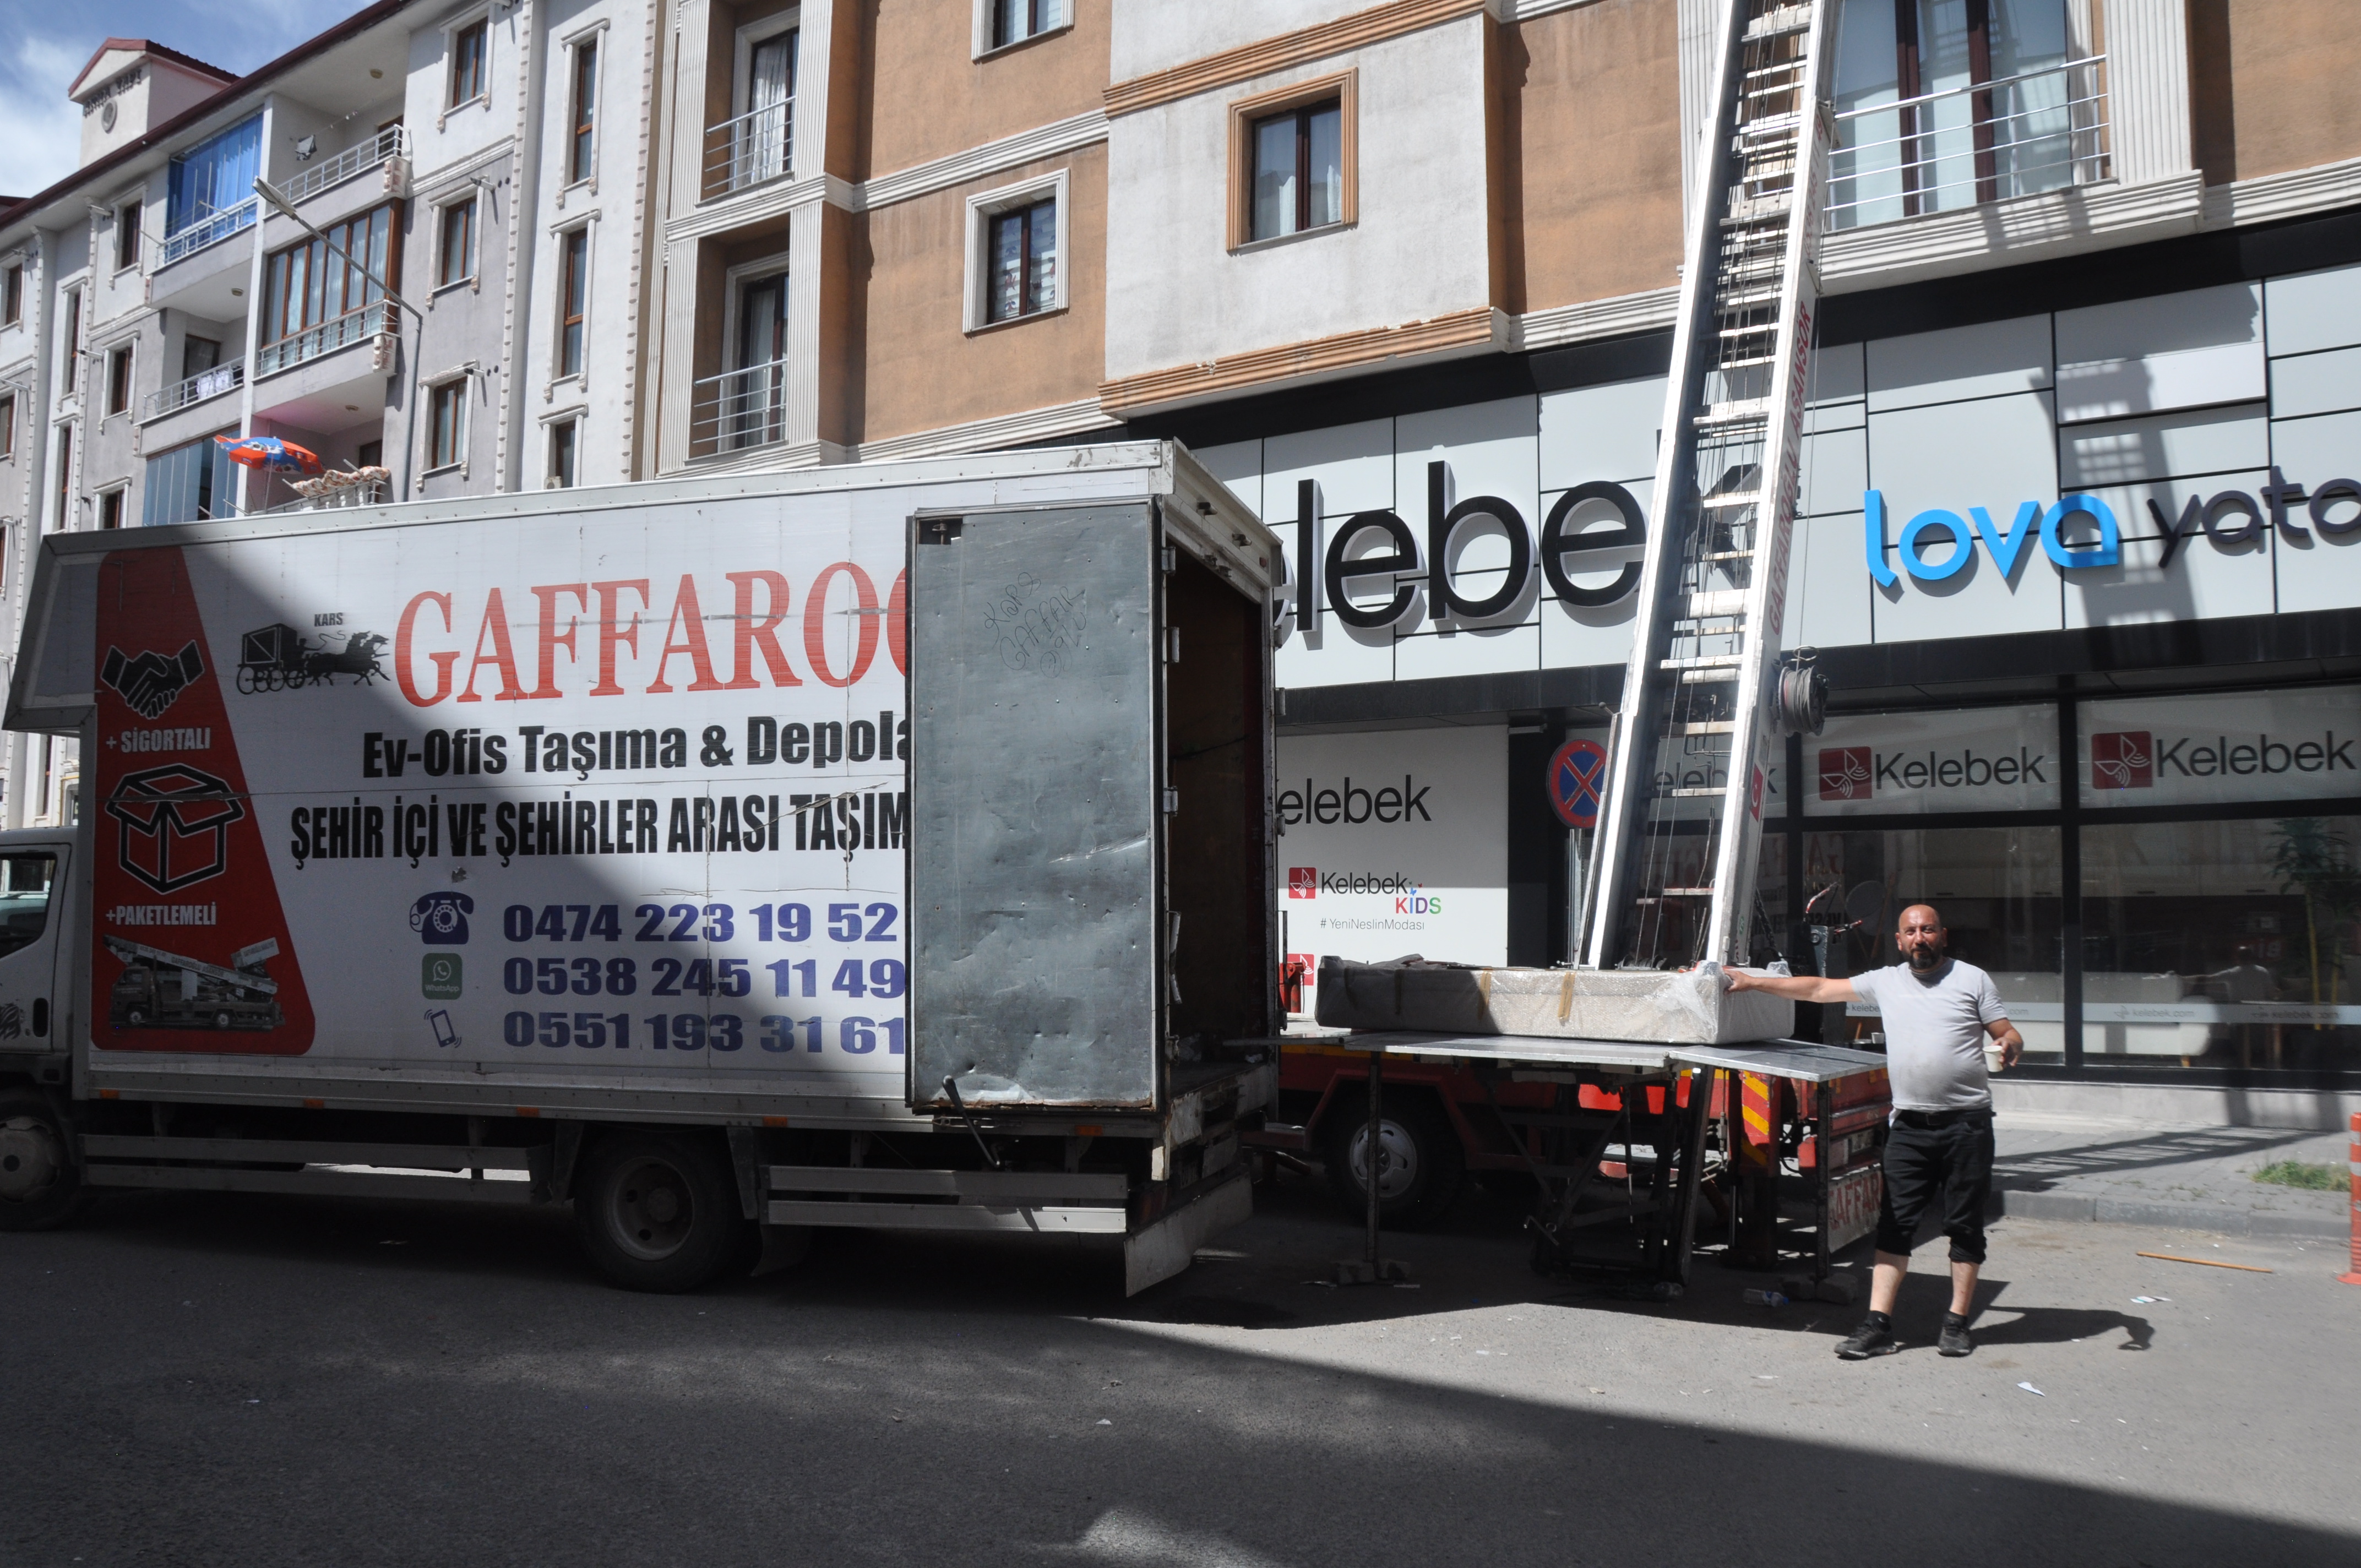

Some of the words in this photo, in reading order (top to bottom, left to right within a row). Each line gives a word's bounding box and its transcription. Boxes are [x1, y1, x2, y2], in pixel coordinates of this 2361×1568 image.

[1769, 439, 1798, 635] GAFFAROĞLU
[1789, 300, 1811, 440] ASANSÖR
[1864, 489, 2119, 587] lova
[314, 612, 344, 627] KARS
[395, 562, 906, 707] GAFFARO
[121, 727, 210, 753] SİGORTALI
[363, 727, 507, 778] Ev-Ofis
[519, 725, 687, 780] Taşıma
[700, 725, 733, 767] &
[2156, 730, 2355, 777] Kelebek
[1875, 745, 2047, 790] Kelebek
[1275, 775, 1432, 824] elebek
[291, 796, 384, 870] ŞEHİR
[394, 793, 438, 869] İÇİ
[448, 802, 487, 858] VE
[496, 791, 657, 868] ŞEHİRLER
[666, 794, 779, 853] ARASI
[1321, 872, 1409, 895] Kelebek
[504, 904, 622, 942] 0474
[635, 903, 735, 942] 223
[749, 902, 812, 942] 19
[828, 902, 898, 942] 52
[1329, 918, 1425, 931] YeniNeslinModası
[425, 984, 460, 993] WhatsApp
[503, 956, 637, 996] 0538
[651, 957, 751, 997] 245
[765, 959, 817, 998] 11
[832, 959, 906, 999] 49
[503, 1011, 629, 1049] 0551
[644, 1013, 743, 1052] 193
[760, 1015, 822, 1053] 31
[840, 1016, 905, 1054] 61
